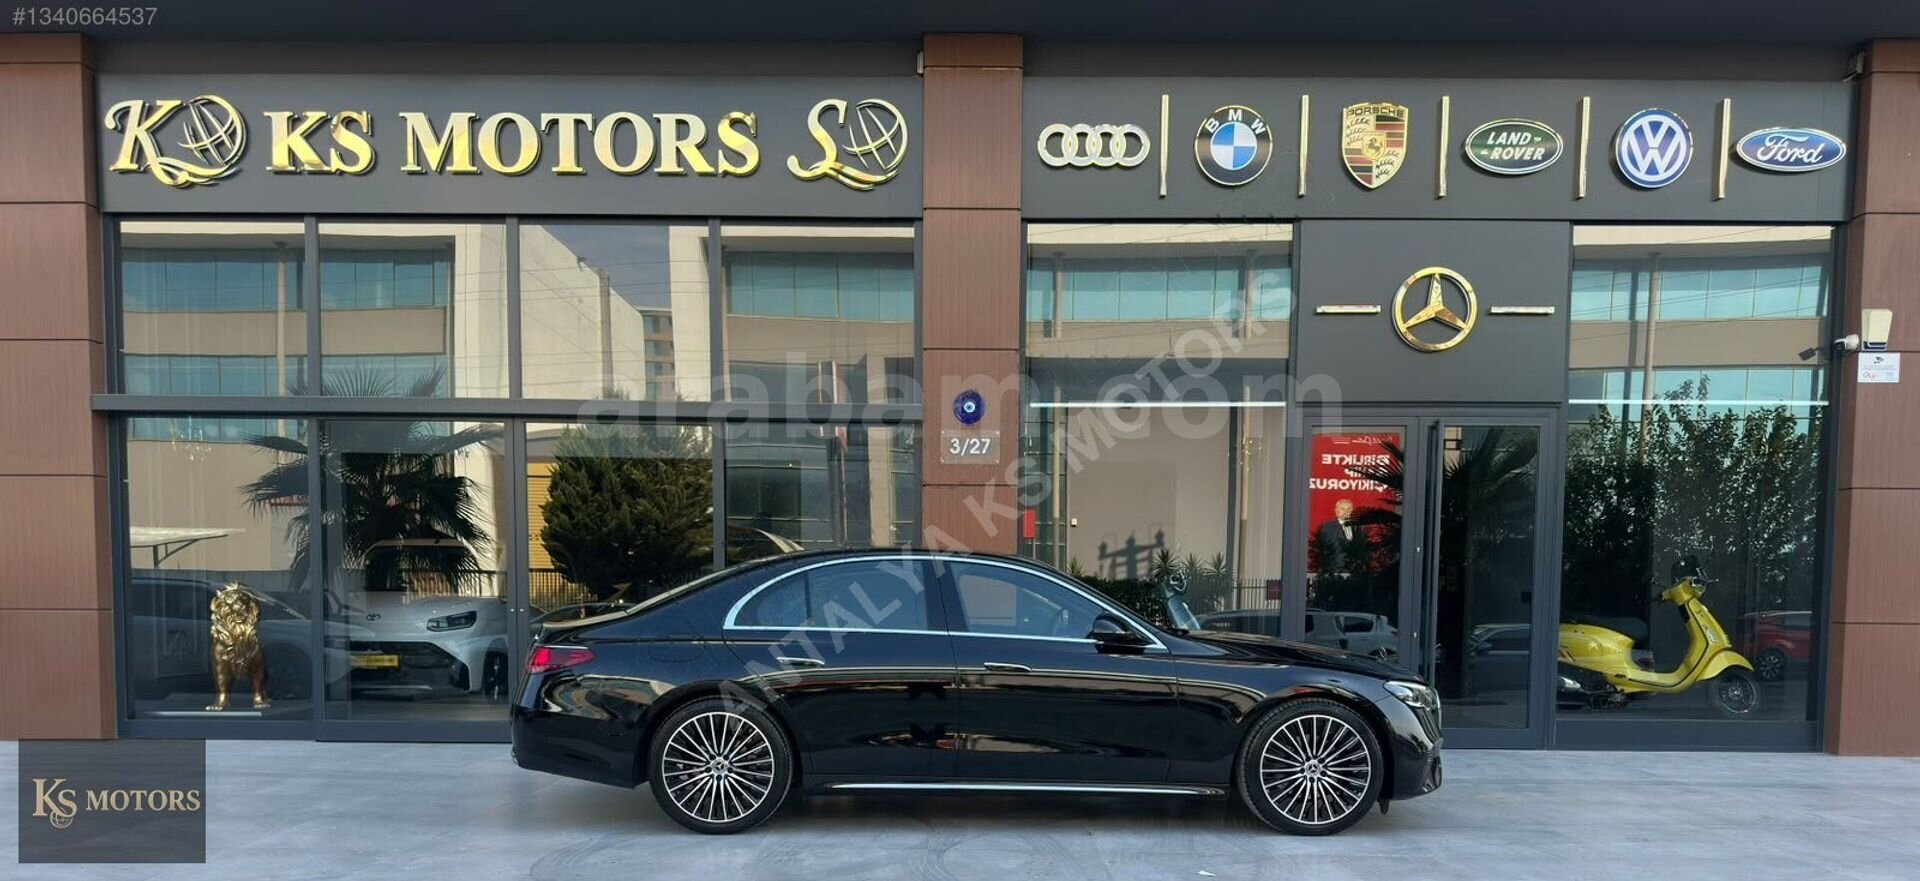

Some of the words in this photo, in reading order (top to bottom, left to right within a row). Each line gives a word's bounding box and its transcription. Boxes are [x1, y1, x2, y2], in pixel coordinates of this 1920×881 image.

[1346, 106, 1404, 118] PORSCHE
[1204, 108, 1266, 135] BMW
[263, 110, 376, 175] KS
[399, 111, 760, 176] MOTORS
[1486, 131, 1532, 145] LAND
[1489, 146, 1546, 160] ROVER
[1756, 134, 1827, 164] Ford
[949, 438, 991, 456] 3/27
